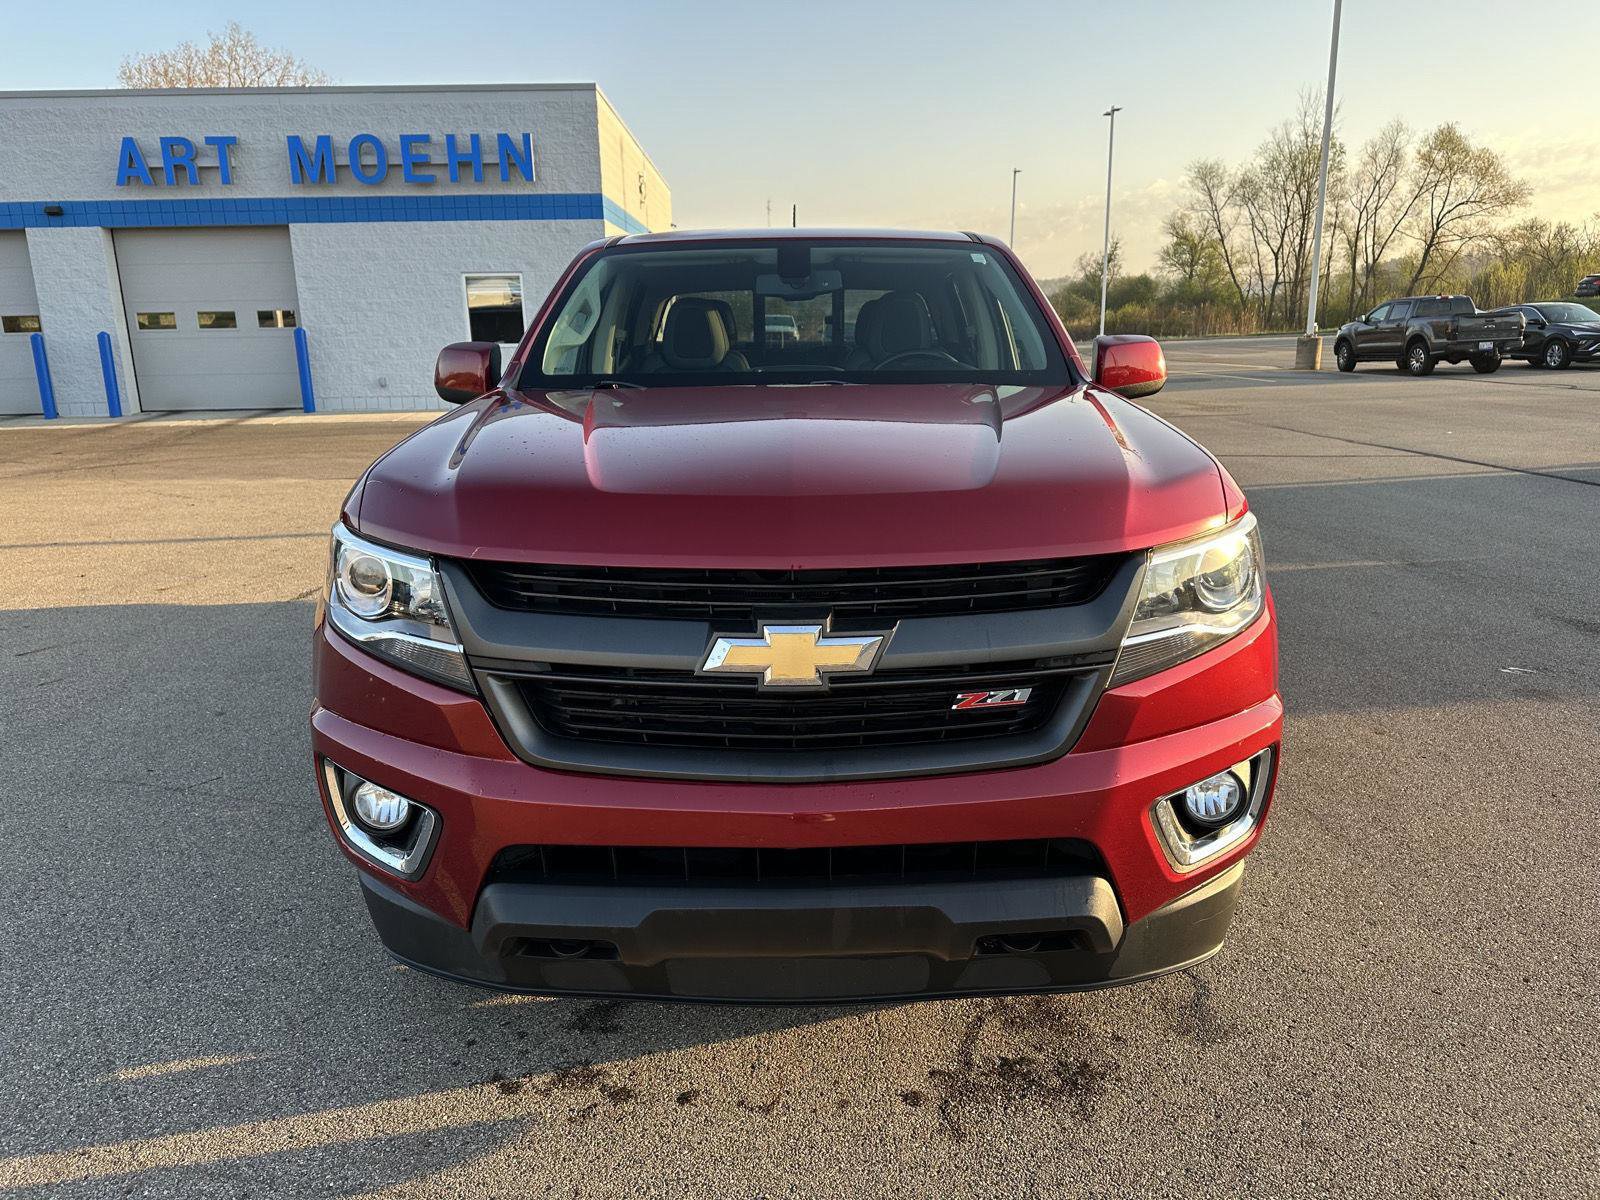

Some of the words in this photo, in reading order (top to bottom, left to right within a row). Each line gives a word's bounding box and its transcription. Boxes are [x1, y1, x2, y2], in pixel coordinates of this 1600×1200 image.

[116, 135, 238, 187] ART
[286, 132, 536, 186] MOEHN
[951, 687, 1033, 710] Z71
